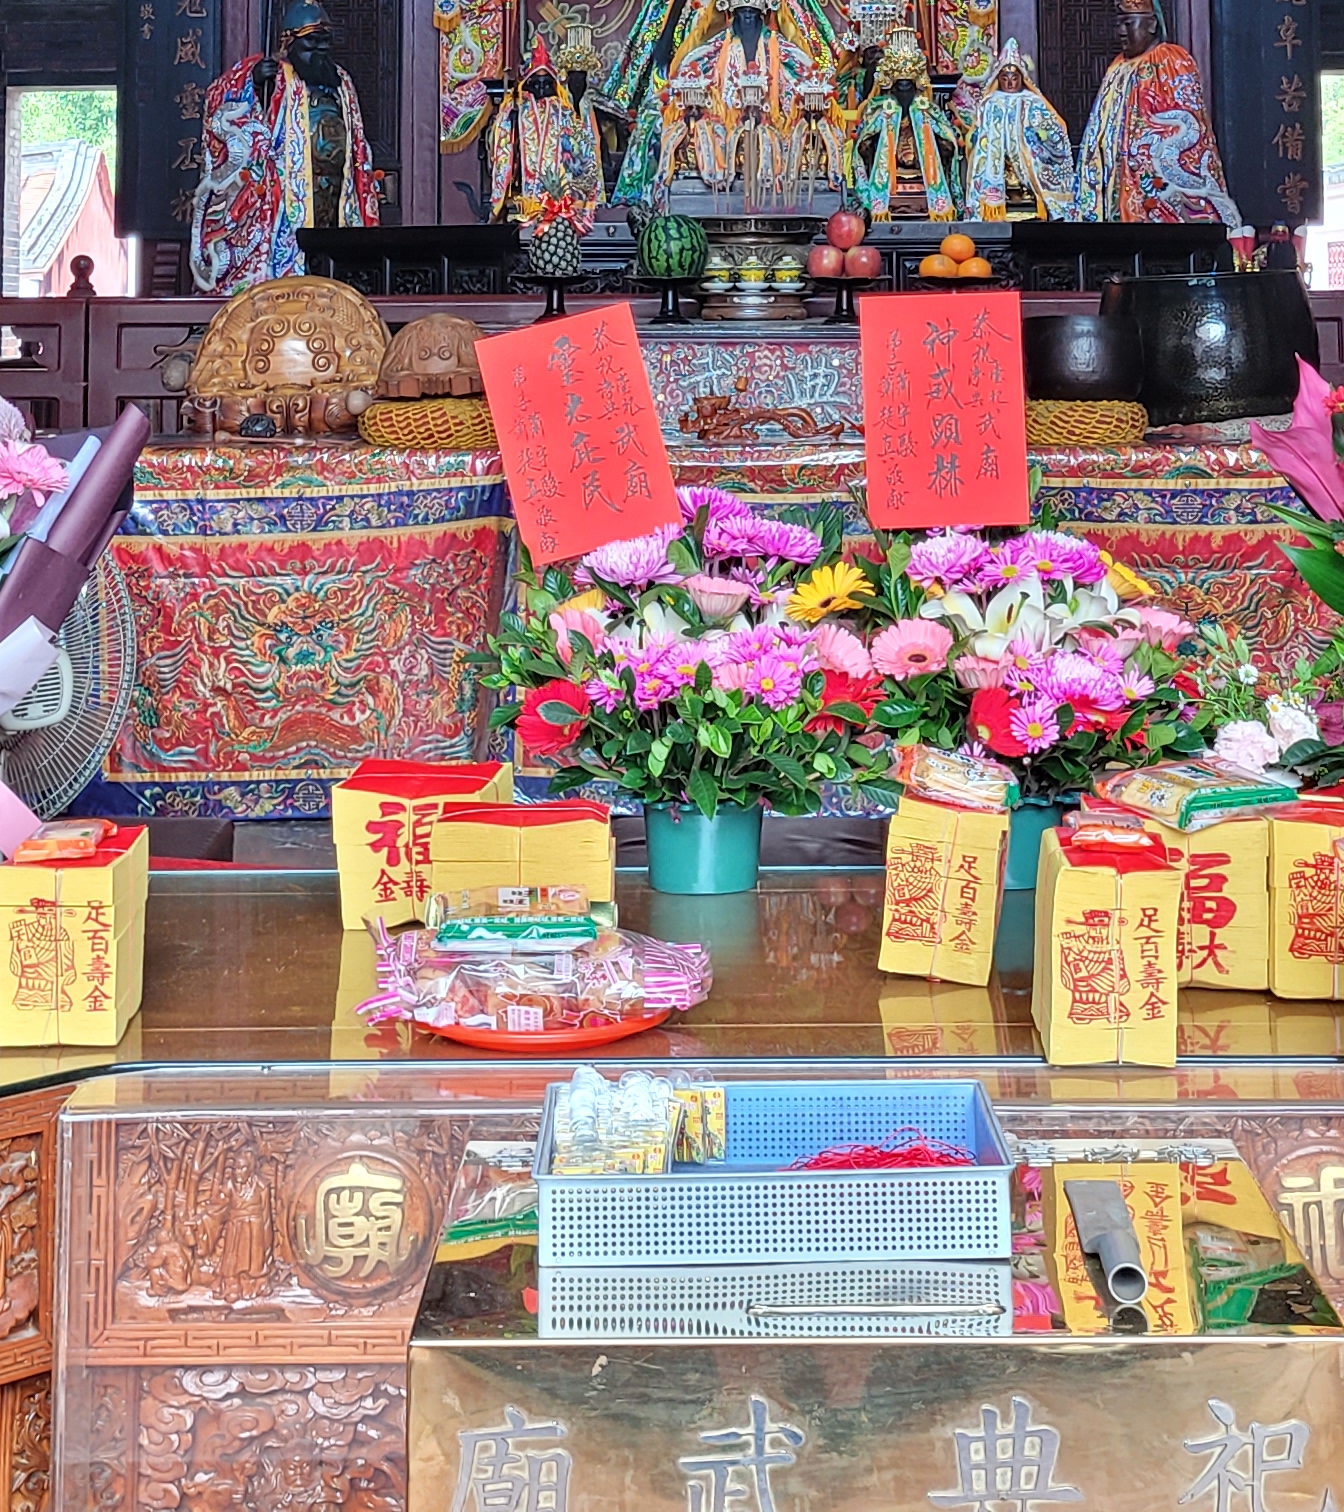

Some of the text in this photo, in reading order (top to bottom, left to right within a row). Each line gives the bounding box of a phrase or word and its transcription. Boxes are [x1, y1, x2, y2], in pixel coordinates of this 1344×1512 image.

[364, 801, 441, 868] 福
[82, 899, 114, 1011] 足百壽金
[948, 854, 979, 955] 足百壽金
[1132, 906, 1170, 1022] 足百壽金
[452, 1394, 1316, 1512] 祀典武廟
